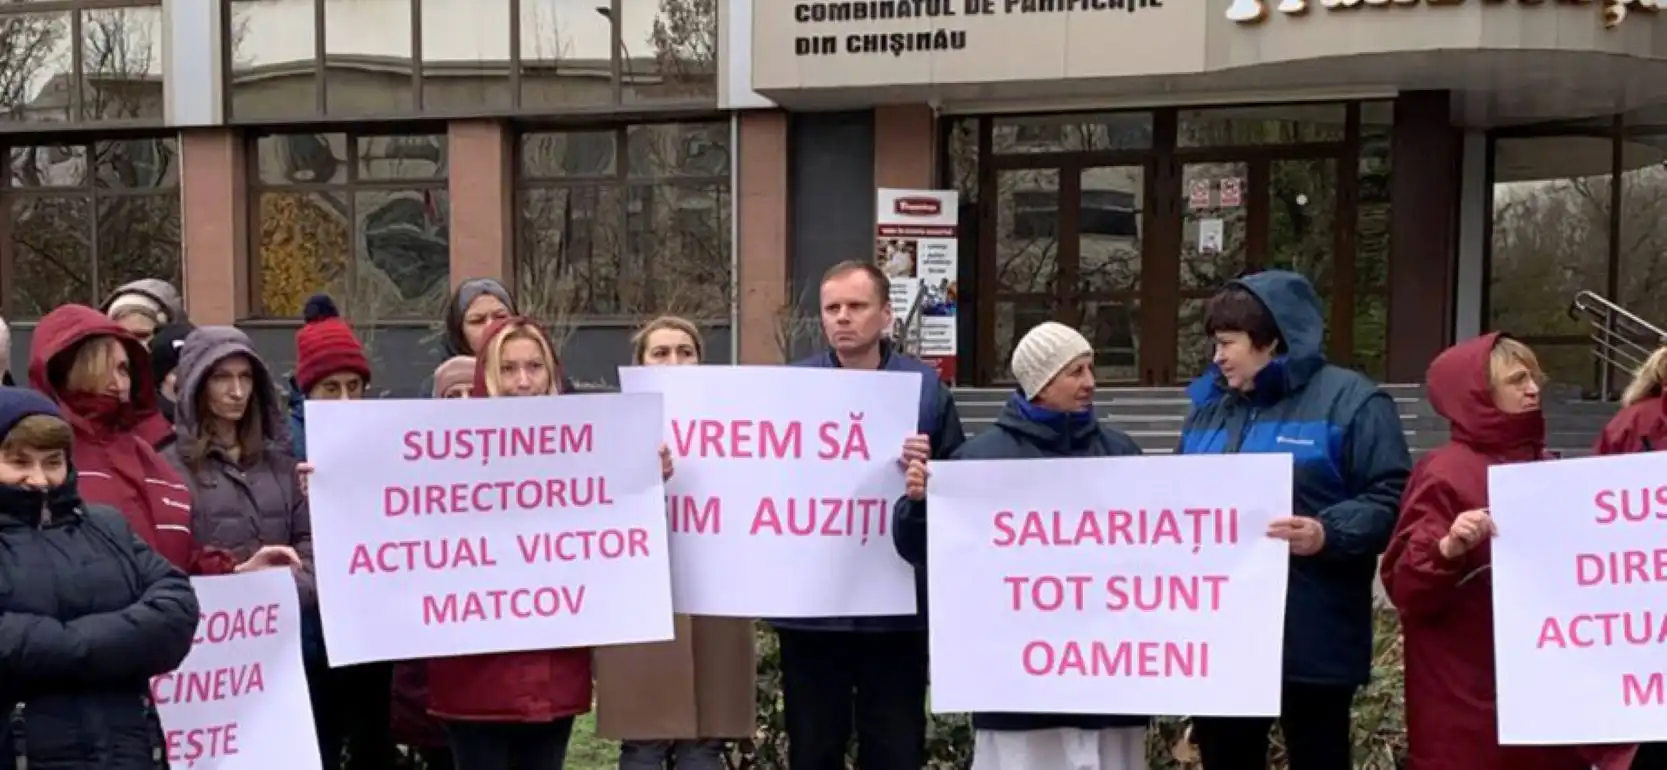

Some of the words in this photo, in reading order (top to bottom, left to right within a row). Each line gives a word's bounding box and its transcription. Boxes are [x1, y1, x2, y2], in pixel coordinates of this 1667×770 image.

[964, 0, 995, 15] DE
[795, 36, 837, 56] DIN
[403, 423, 594, 465] SUSȚINEM
[671, 419, 803, 459] VREM
[818, 411, 871, 461] SĂ
[383, 476, 613, 517] DIRECTORUL
[665, 494, 721, 535] IM
[749, 496, 888, 546] AUZIȚI
[993, 507, 1239, 554] SALARIAȚII
[348, 537, 497, 575] ACTUAL
[516, 527, 650, 565] VICTOR
[1575, 547, 1667, 587] DIRE
[422, 585, 586, 625] MATCOV
[1003, 575, 1093, 612] TOT
[1105, 575, 1229, 613] SUNT
[1022, 640, 1209, 677] OAMENI
[151, 661, 264, 705] CINEVA
[1621, 672, 1665, 706] M
